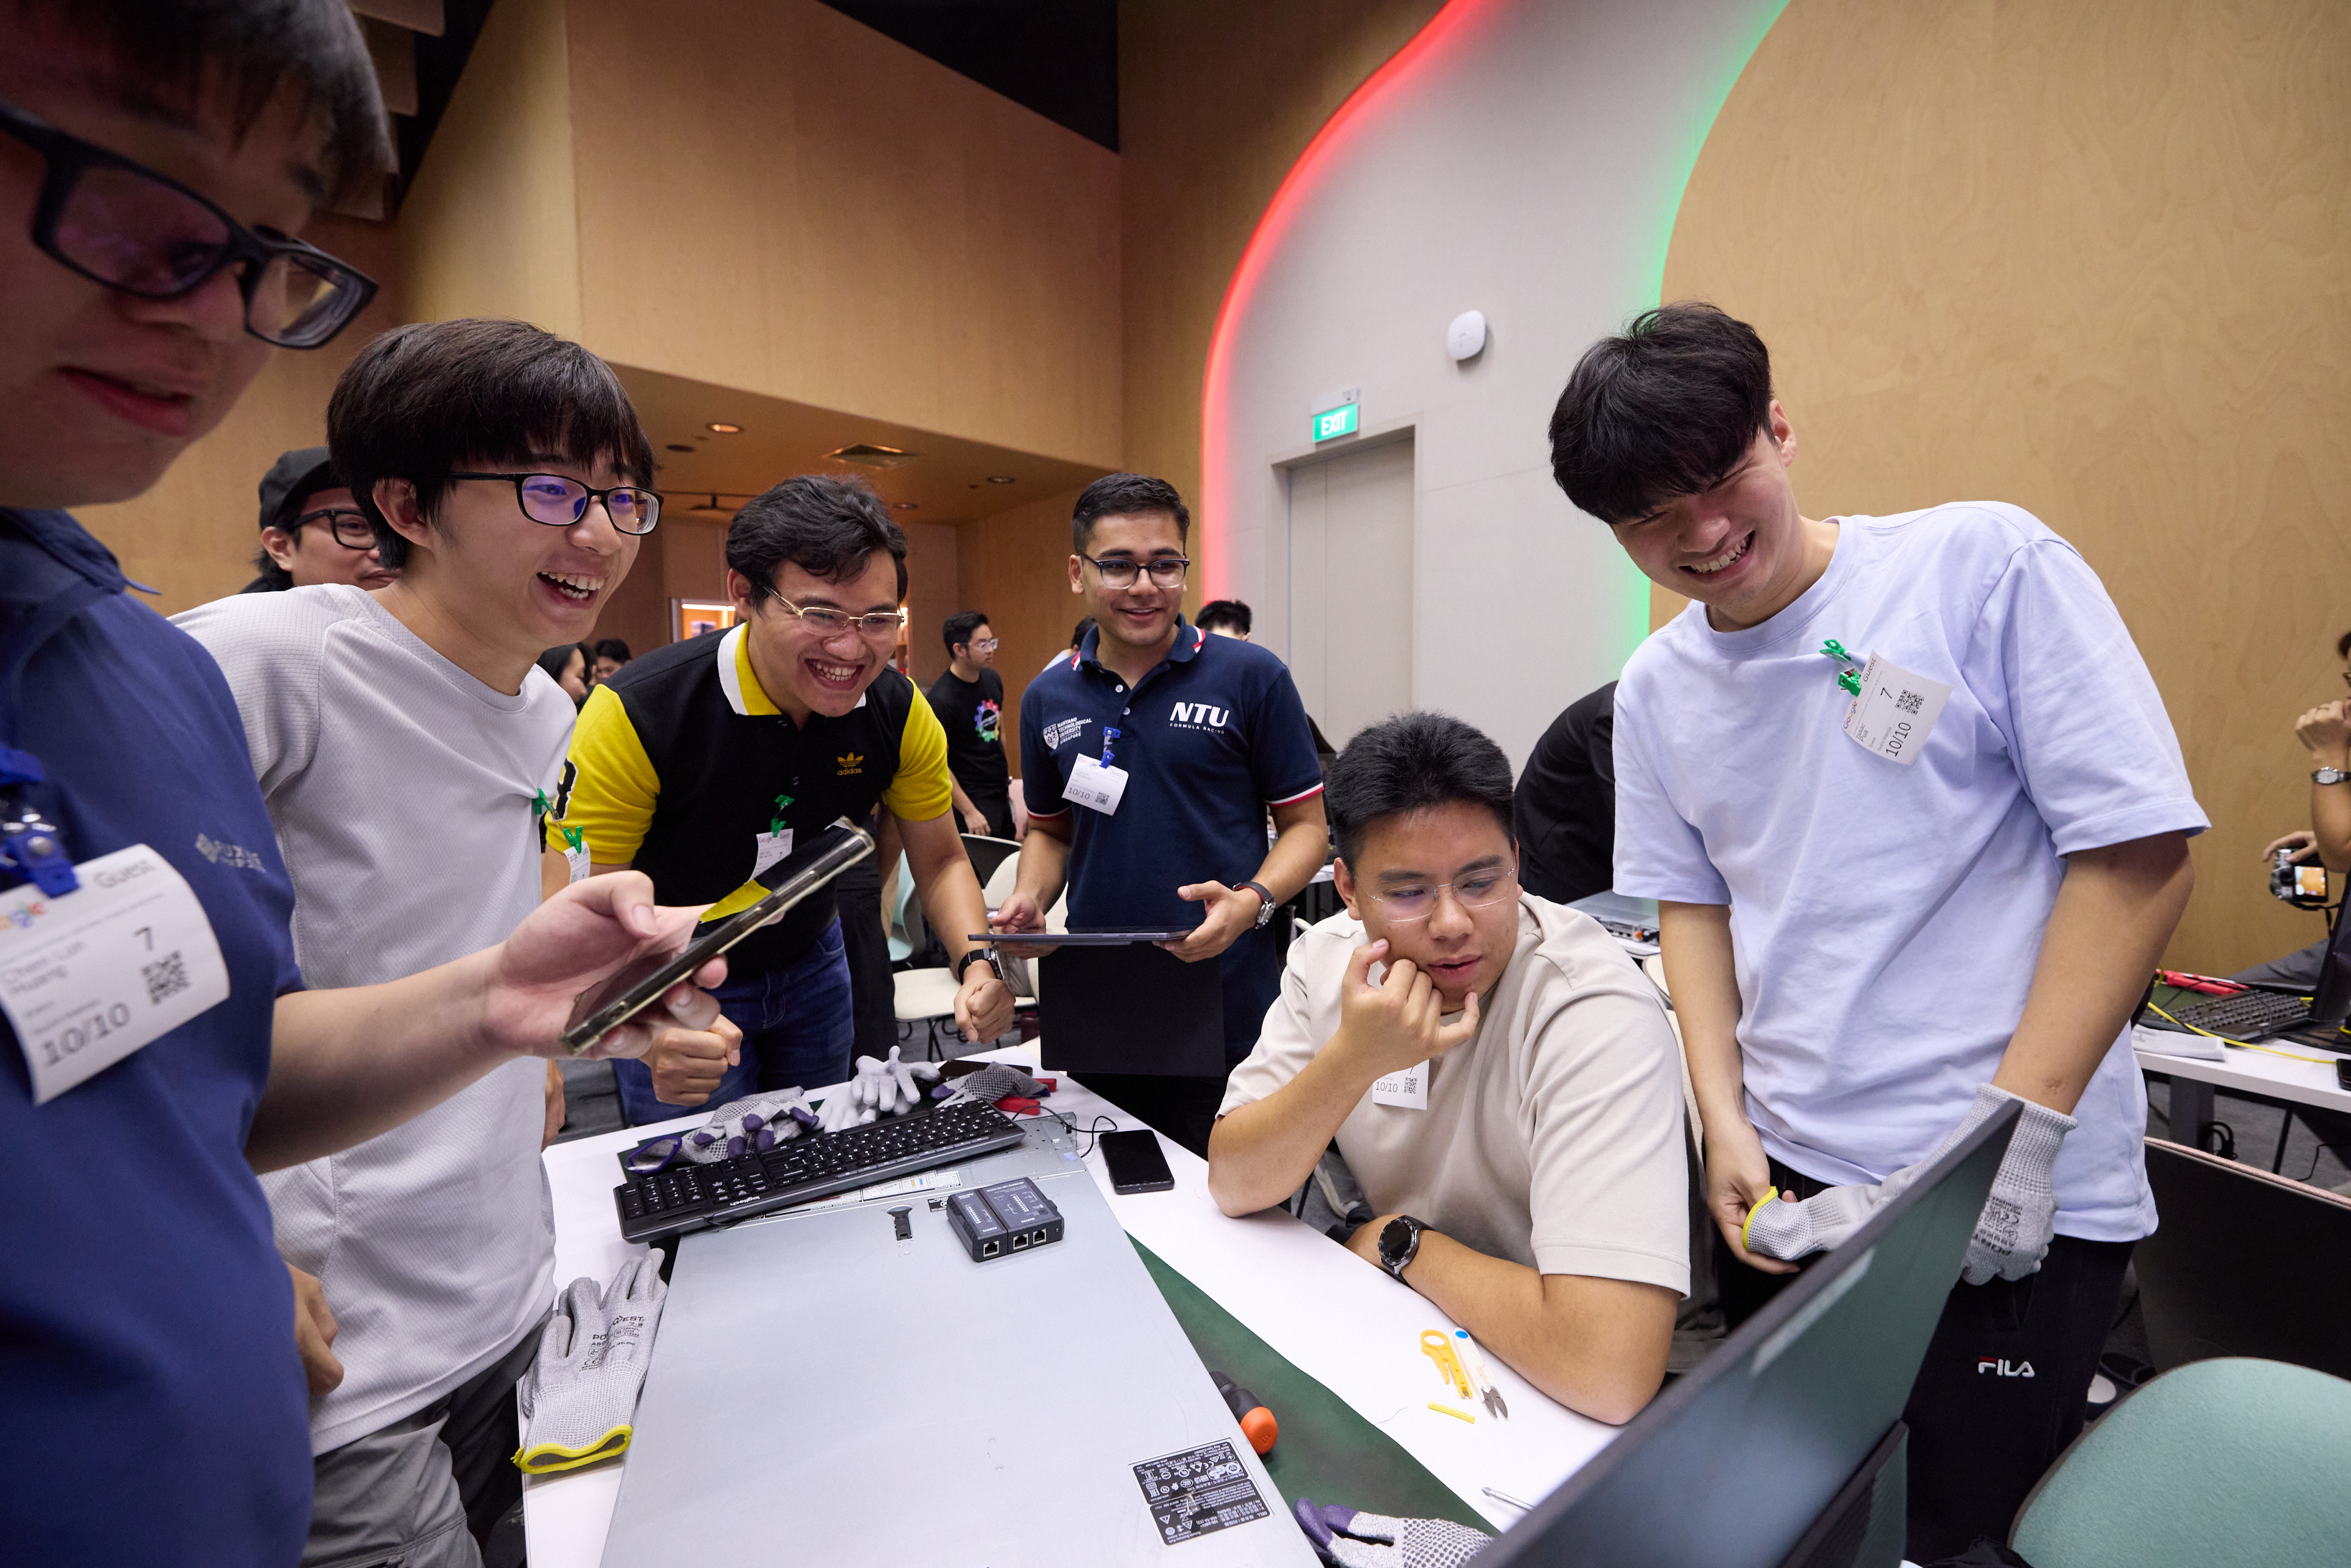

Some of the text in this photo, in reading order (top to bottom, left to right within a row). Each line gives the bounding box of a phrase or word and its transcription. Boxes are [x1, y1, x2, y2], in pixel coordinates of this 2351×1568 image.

[1321, 411, 1348, 436] EXIT
[1864, 658, 1876, 681] Guest
[1880, 687, 1892, 699] 7
[1170, 702, 1230, 727] NTU
[1844, 702, 1857, 729] Google
[1886, 722, 1911, 757] 10/10
[1078, 757, 1097, 768] Google
[1068, 788, 1090, 799] 10/10
[42, 1002, 131, 1066] 10/10
[1376, 1082, 1398, 1092] 10/10
[729, 1196, 760, 1206] logitech
[1978, 1356, 2035, 1377] FILA
